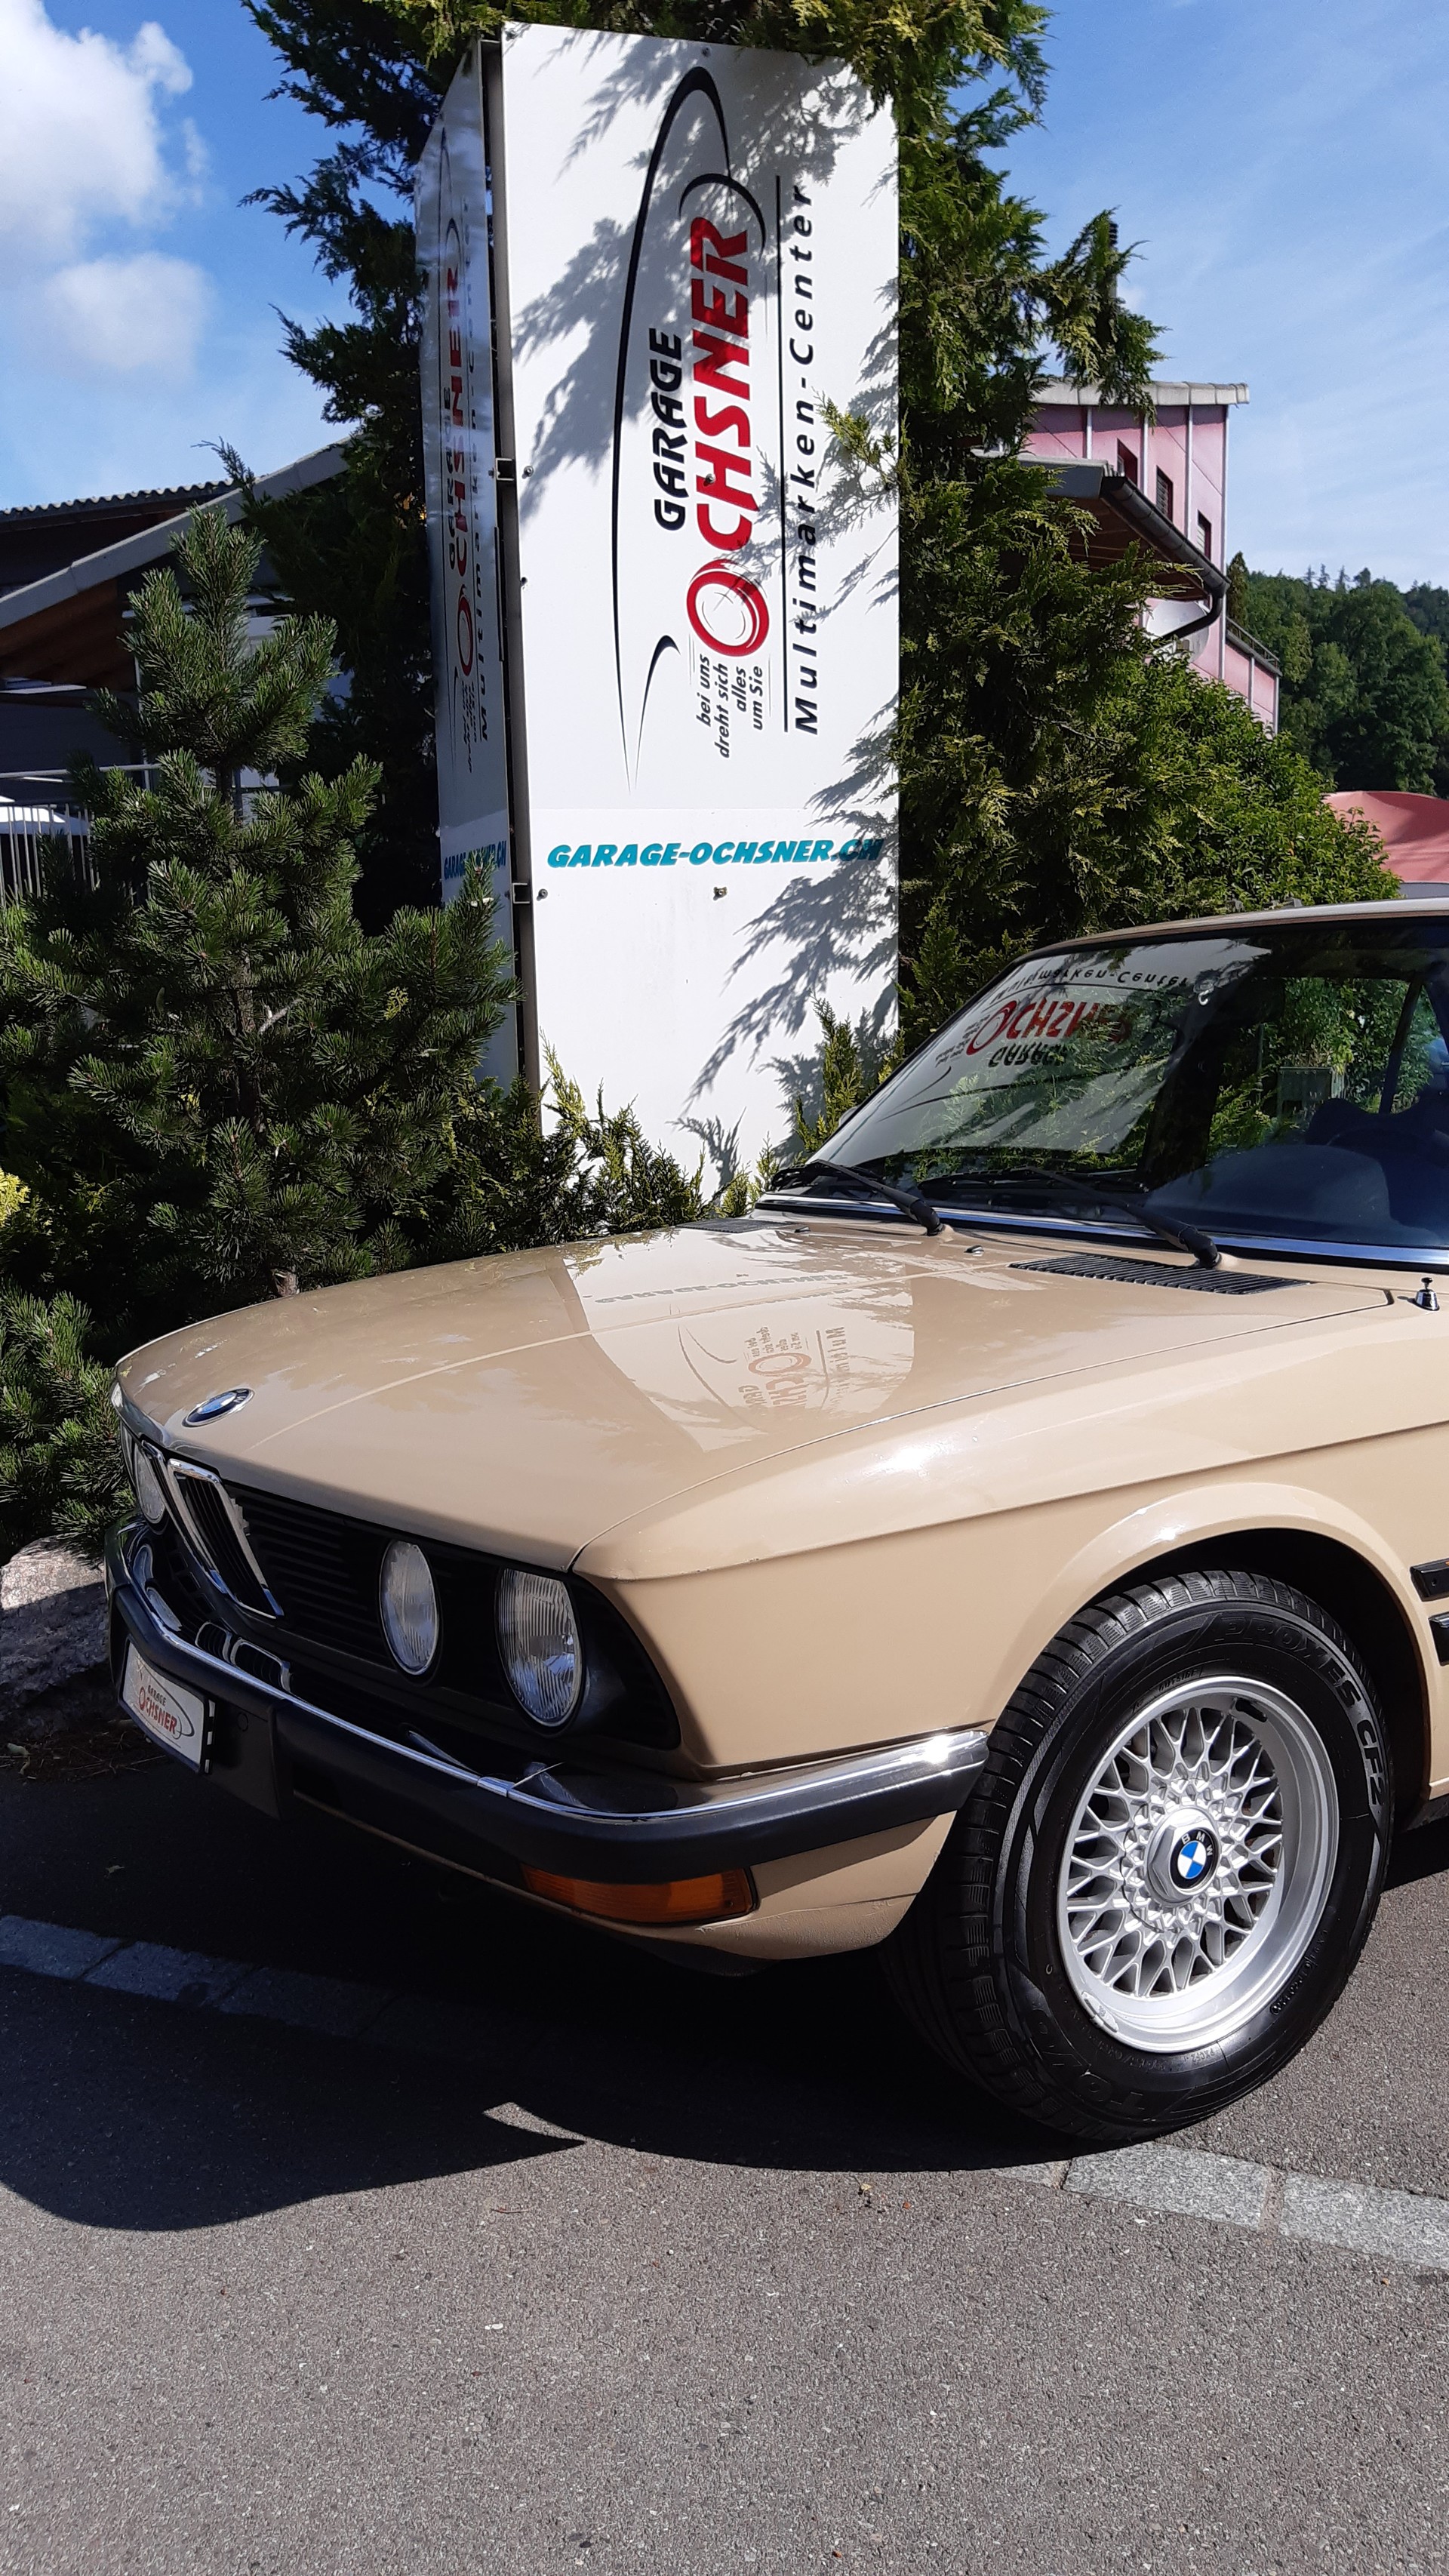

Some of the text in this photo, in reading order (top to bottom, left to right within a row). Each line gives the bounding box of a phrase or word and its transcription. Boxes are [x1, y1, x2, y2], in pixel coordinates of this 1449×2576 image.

[649, 328, 687, 531] GARAGE
[686, 217, 770, 656] OCHSNER
[789, 185, 818, 735] Multimarken-Center
[443, 386, 459, 569] GARAGE
[696, 654, 712, 727] bei uns
[712, 663, 730, 759] dreht sich
[731, 666, 747, 712] alles
[749, 666, 763, 731] um Sie
[547, 839, 884, 869] GARAGE-OCHSNER.CH
[147, 1685, 167, 1707] GARAGE
[1214, 1615, 1363, 1710] PROXES
[139, 1686, 177, 1735] OCHSNER
[1355, 1719, 1386, 1807] CF2
[1181, 1831, 1214, 1857] BMW
